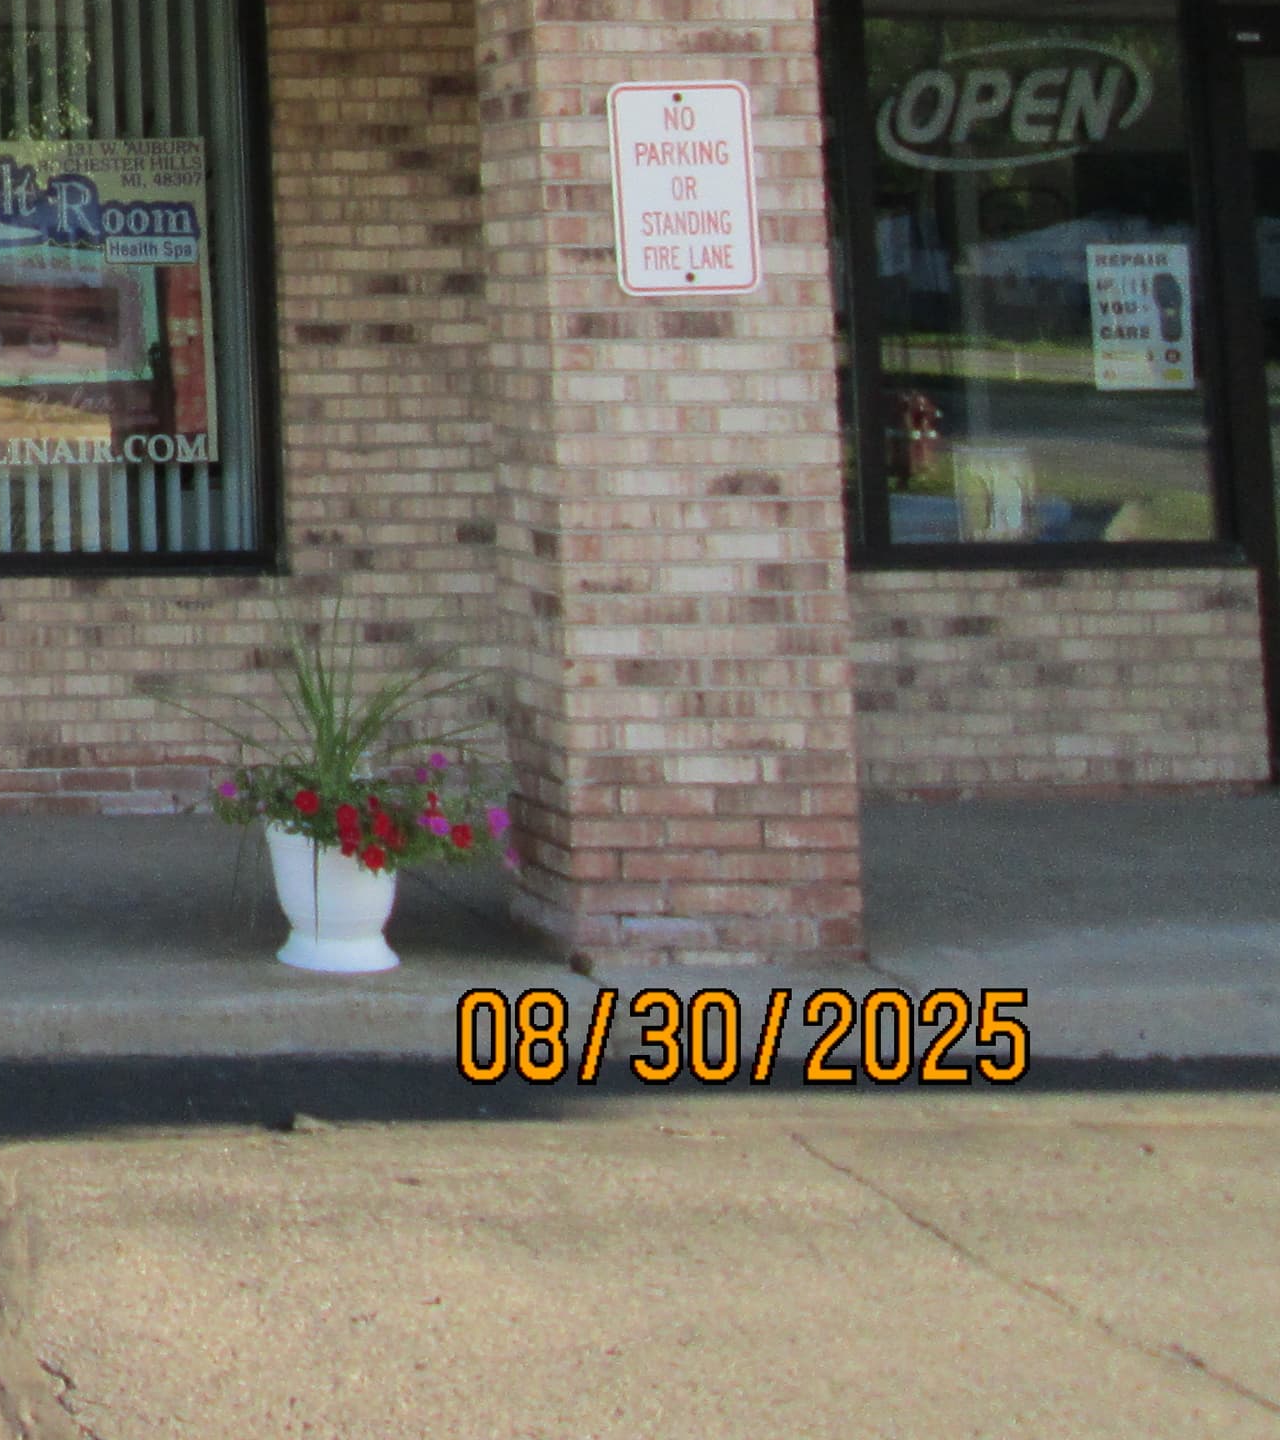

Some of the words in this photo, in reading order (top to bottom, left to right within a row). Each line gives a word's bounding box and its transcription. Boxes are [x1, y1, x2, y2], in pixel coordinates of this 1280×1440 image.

[895, 66, 1125, 144] OPEN
[663, 106, 696, 132] NO
[37, 157, 145, 172] RCHESTER
[150, 156, 202, 171] HILLS
[634, 140, 730, 167] PARKING
[671, 175, 698, 201] OR
[48, 179, 192, 236] Room
[641, 210, 733, 237] STANDING
[109, 240, 158, 257] Health
[163, 240, 192, 261] Spa
[643, 245, 682, 271] FIRE
[689, 244, 735, 270] LANE
